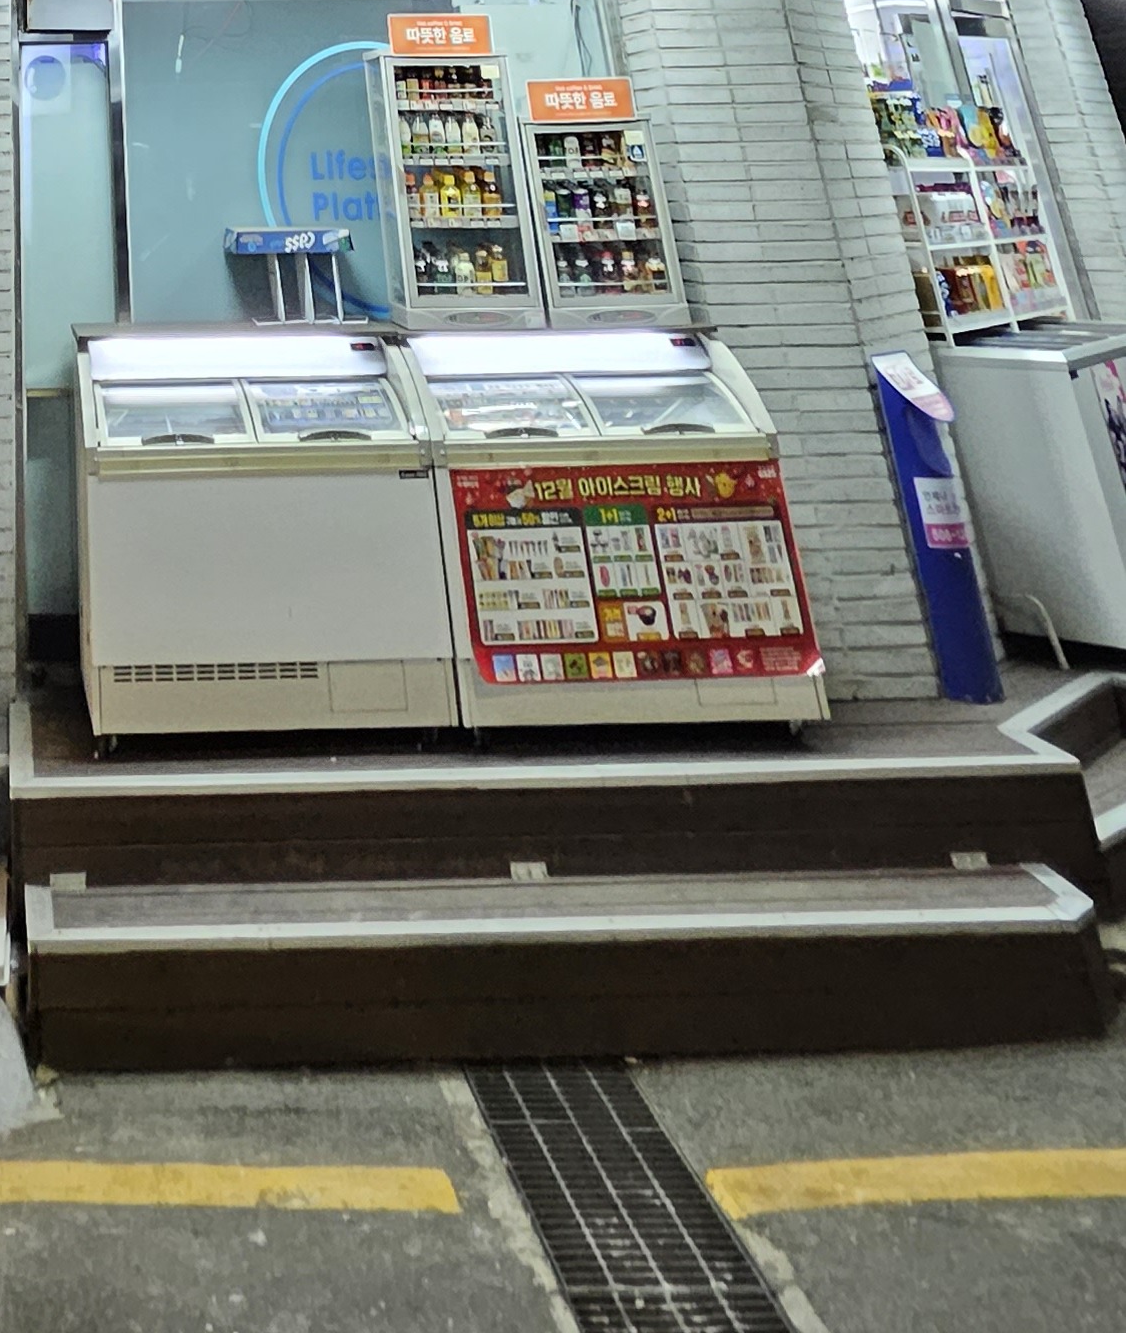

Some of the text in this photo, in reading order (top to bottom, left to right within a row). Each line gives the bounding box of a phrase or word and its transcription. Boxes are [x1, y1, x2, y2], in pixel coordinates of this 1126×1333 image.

[405, 26, 477, 45] 따뜻한 음료
[544, 91, 618, 111] 따뜻한 음료
[312, 191, 379, 221] Plat
[534, 473, 702, 501] 12월 아이스크림 행사
